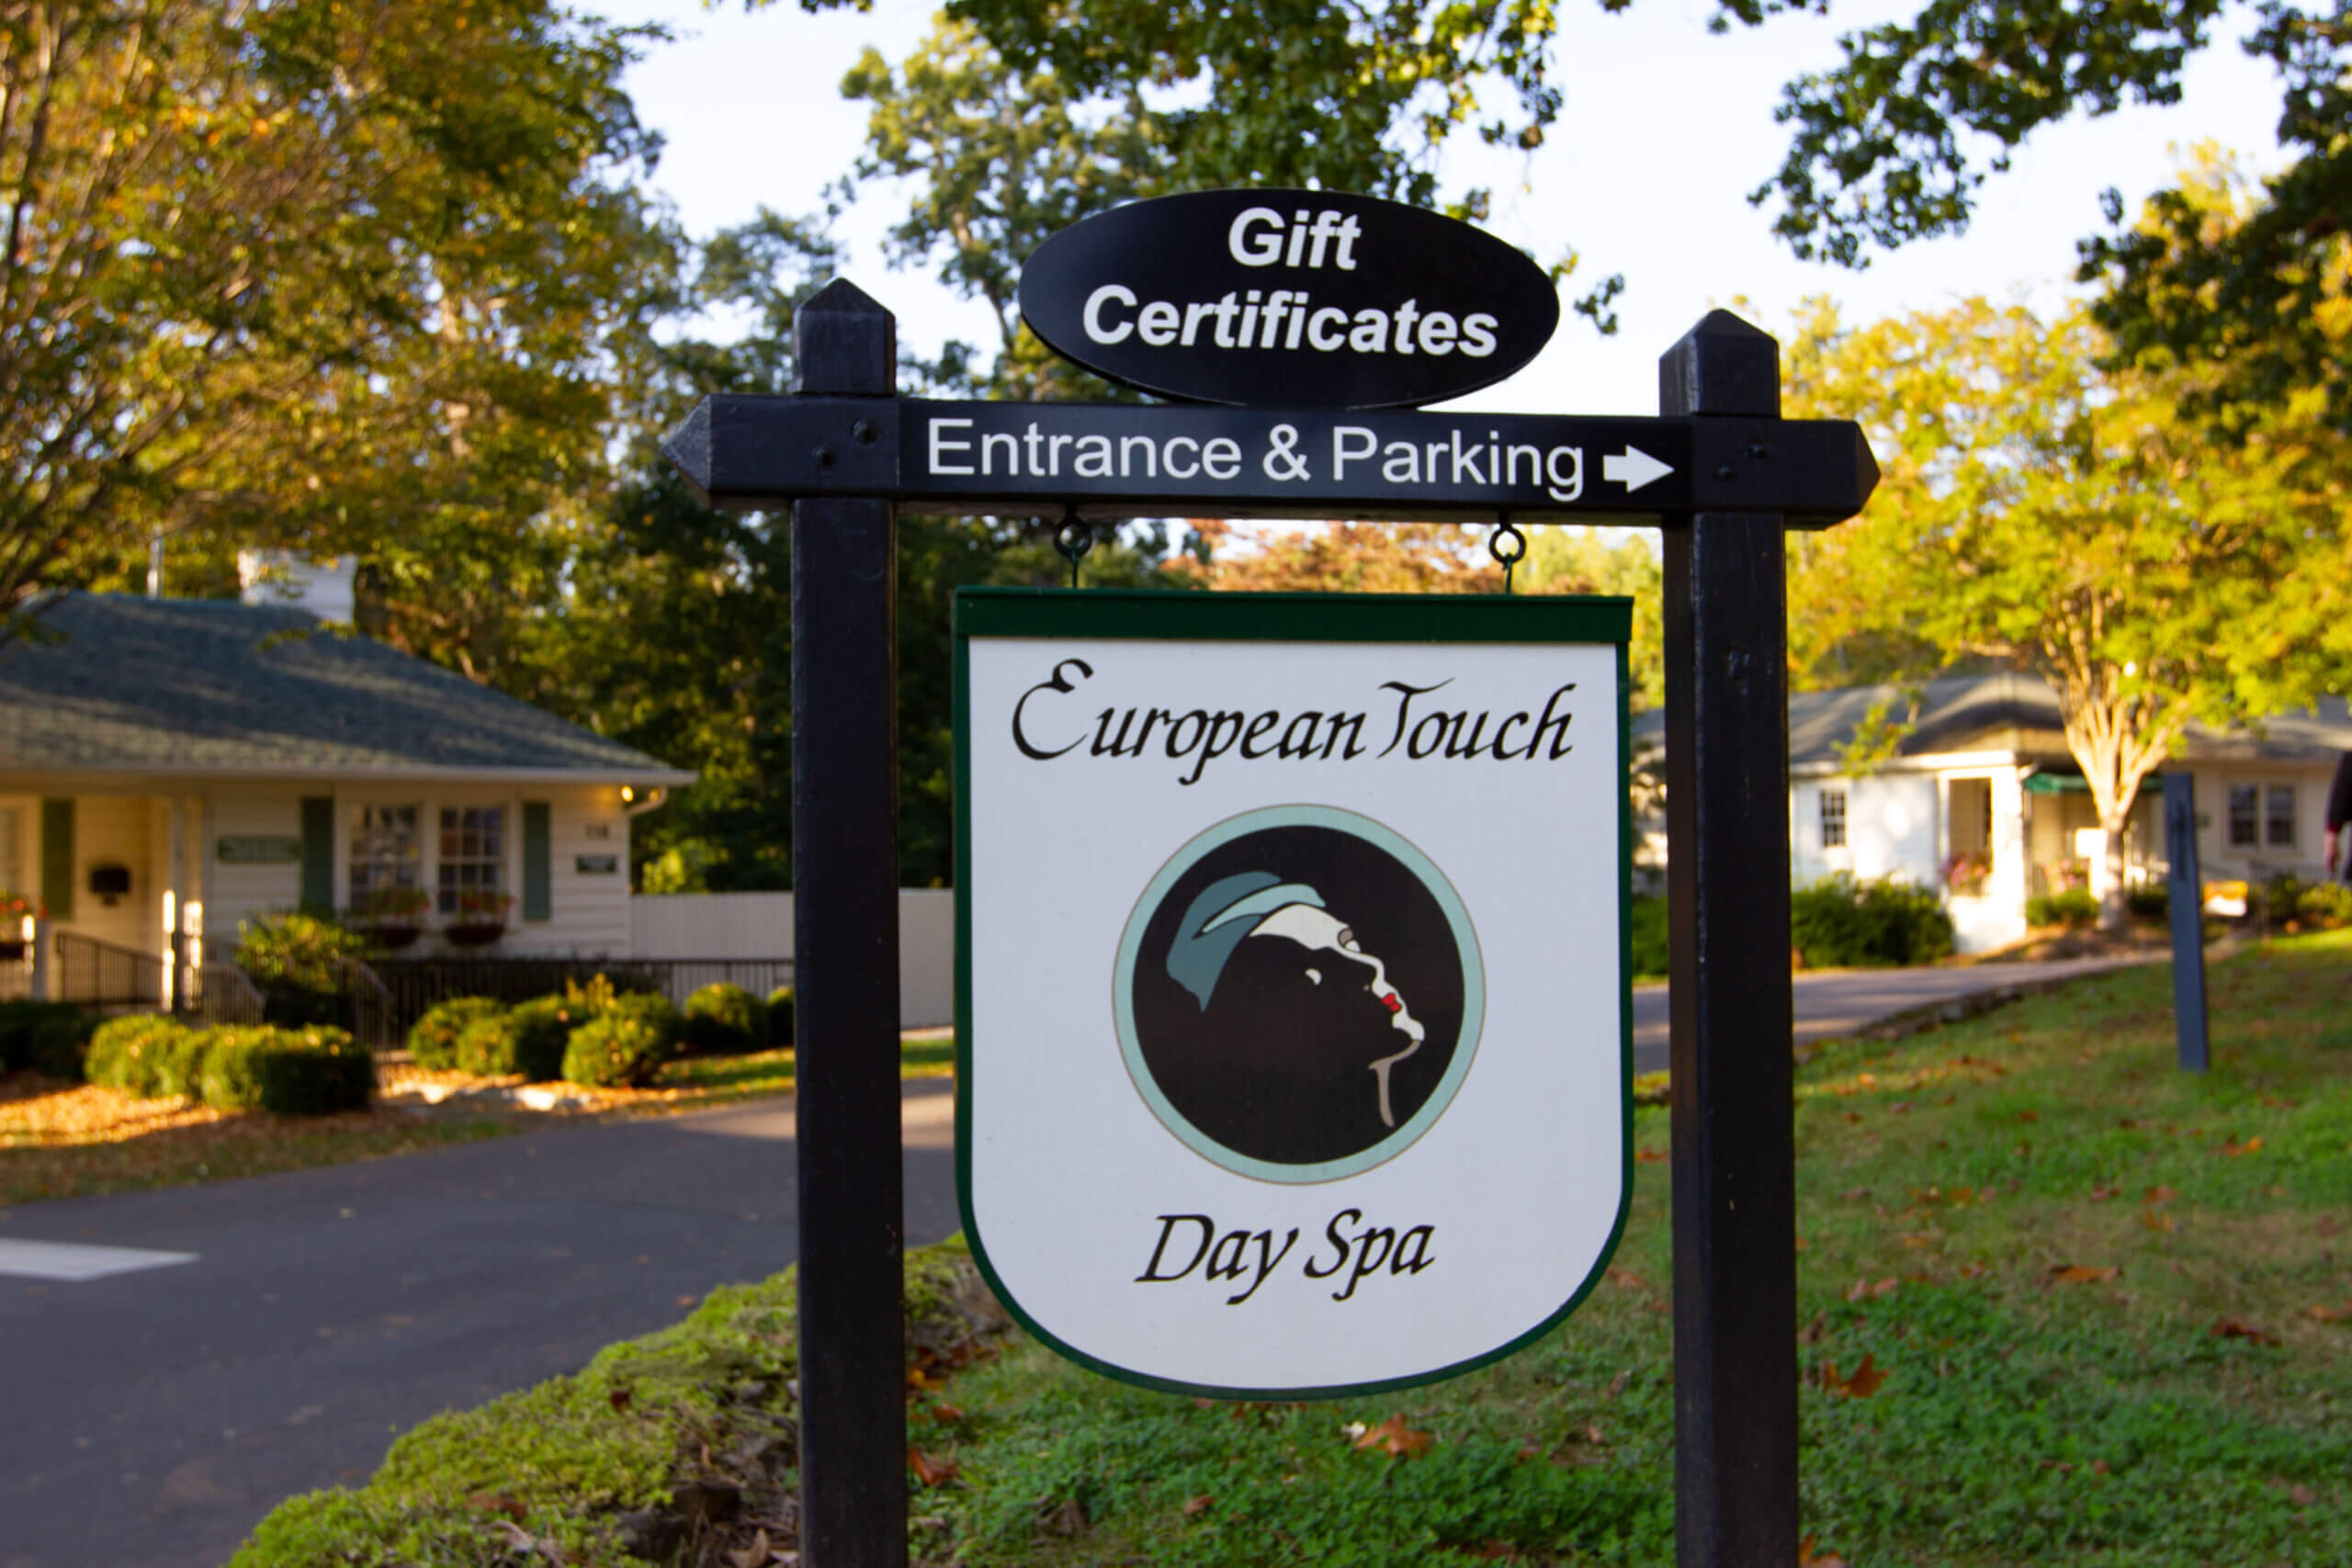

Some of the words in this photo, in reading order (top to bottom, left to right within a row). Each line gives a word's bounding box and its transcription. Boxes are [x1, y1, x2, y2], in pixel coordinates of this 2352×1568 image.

[1228, 207, 1362, 270] Gift
[1083, 284, 1498, 357] Certificates
[929, 418, 1242, 480] Entrance
[1262, 423, 1311, 481] &
[1333, 425, 1583, 502] Parking
[1012, 658, 1367, 786] European
[1376, 677, 1577, 761] Touch
[1134, 1213, 1299, 1305] Day
[1303, 1208, 1436, 1302] Spa
